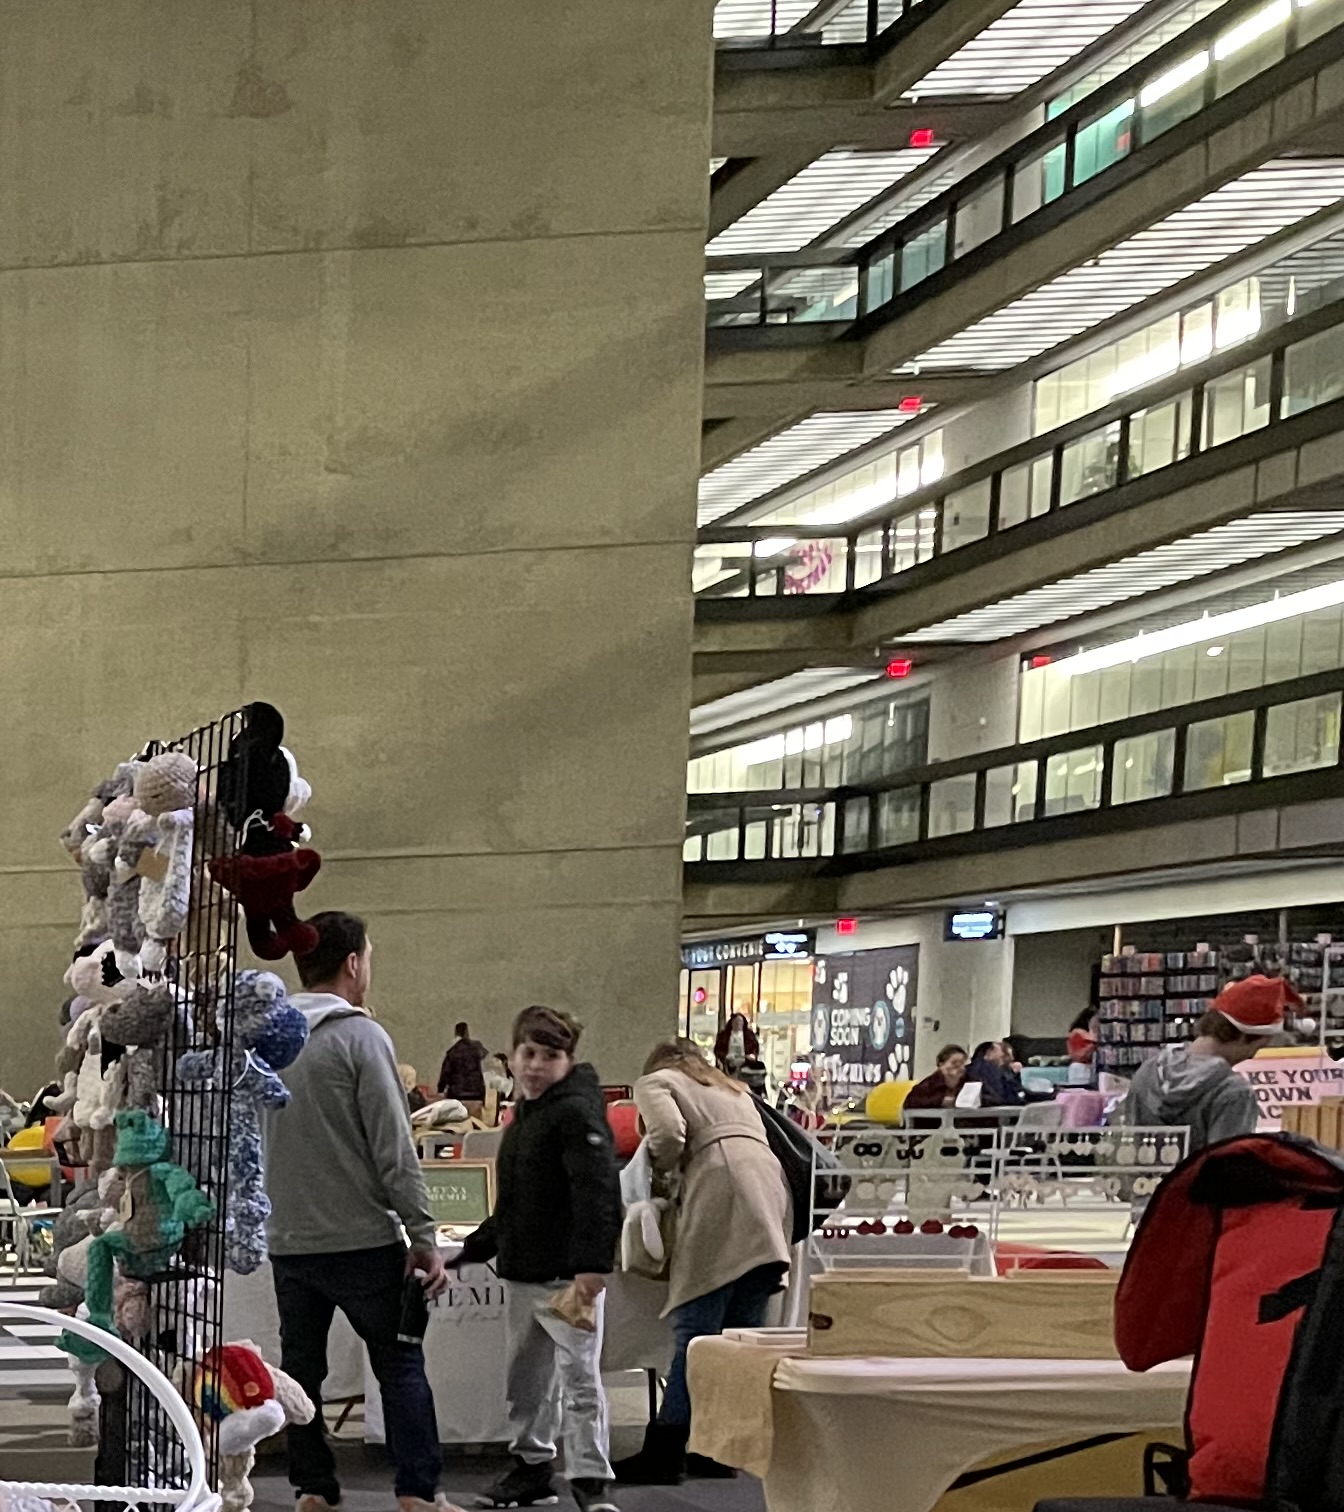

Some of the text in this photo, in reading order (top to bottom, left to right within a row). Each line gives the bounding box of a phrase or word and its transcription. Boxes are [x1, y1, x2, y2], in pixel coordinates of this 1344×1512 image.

[830, 1007, 871, 1027] COMING
[829, 1027, 860, 1046] SOON
[1254, 1087, 1313, 1102] OWN
